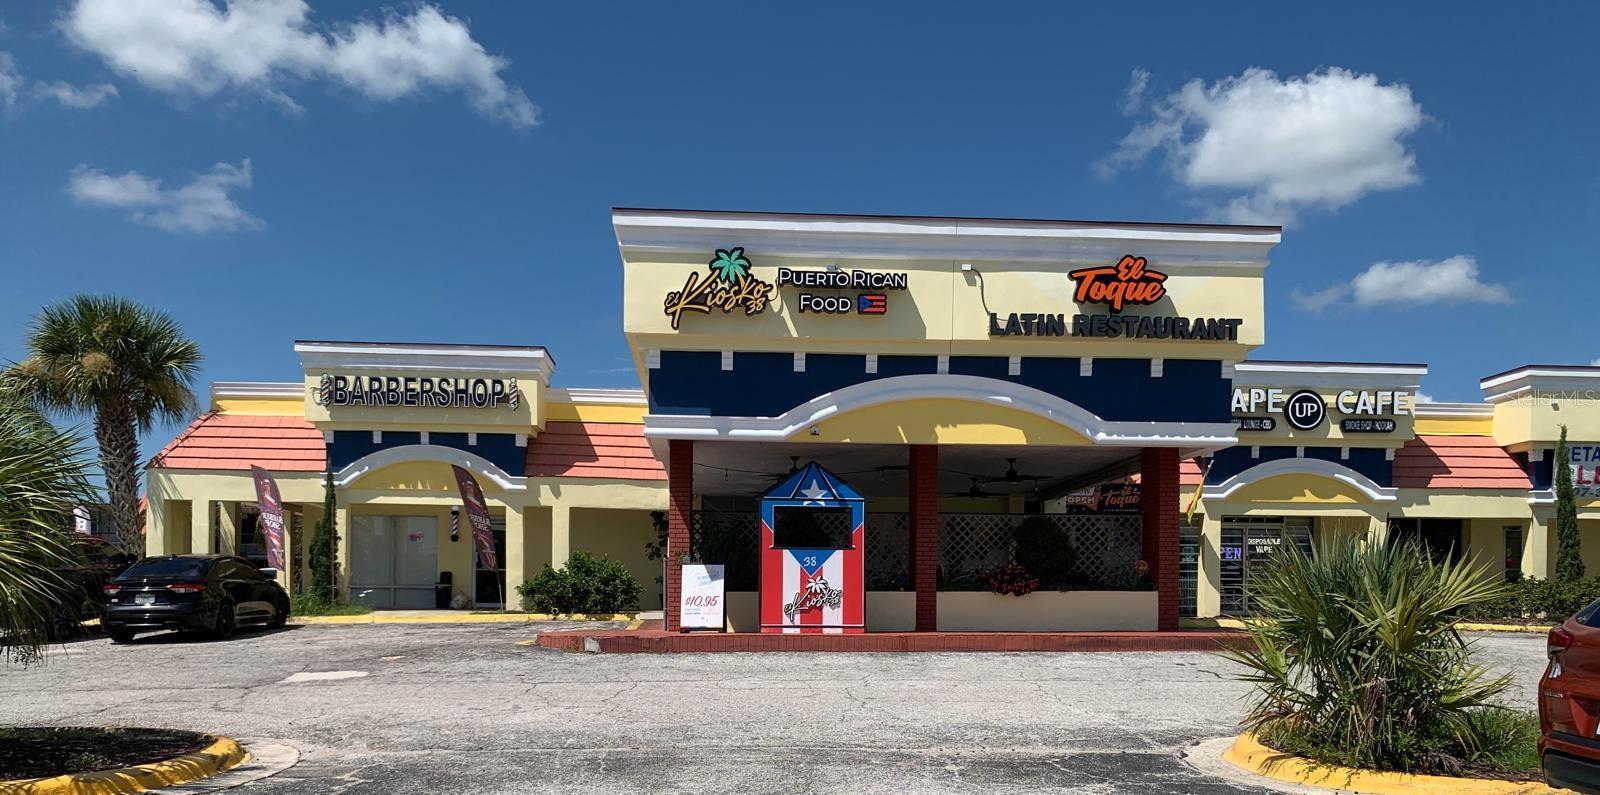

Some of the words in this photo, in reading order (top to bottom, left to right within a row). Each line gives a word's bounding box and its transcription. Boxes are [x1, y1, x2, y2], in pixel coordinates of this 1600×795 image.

[778, 268, 849, 287] PUERTO
[852, 270, 908, 289] RICAN
[1117, 255, 1145, 280] El
[665, 293, 679, 307] El
[666, 270, 771, 328] Kiosko
[1070, 267, 1168, 311] Toque
[745, 297, 766, 314] 38
[799, 294, 852, 312] FOOD
[989, 312, 1065, 337] LATIN
[1071, 314, 1243, 341] RESTAURANT
[333, 375, 505, 408] BARBERSHOP
[1231, 388, 1283, 413] APE
[1294, 403, 1318, 418] UP
[1336, 390, 1409, 415] CAFE
[803, 556, 817, 567] 38
[685, 595, 721, 608] $10.95
[785, 587, 842, 622] Kiosko
